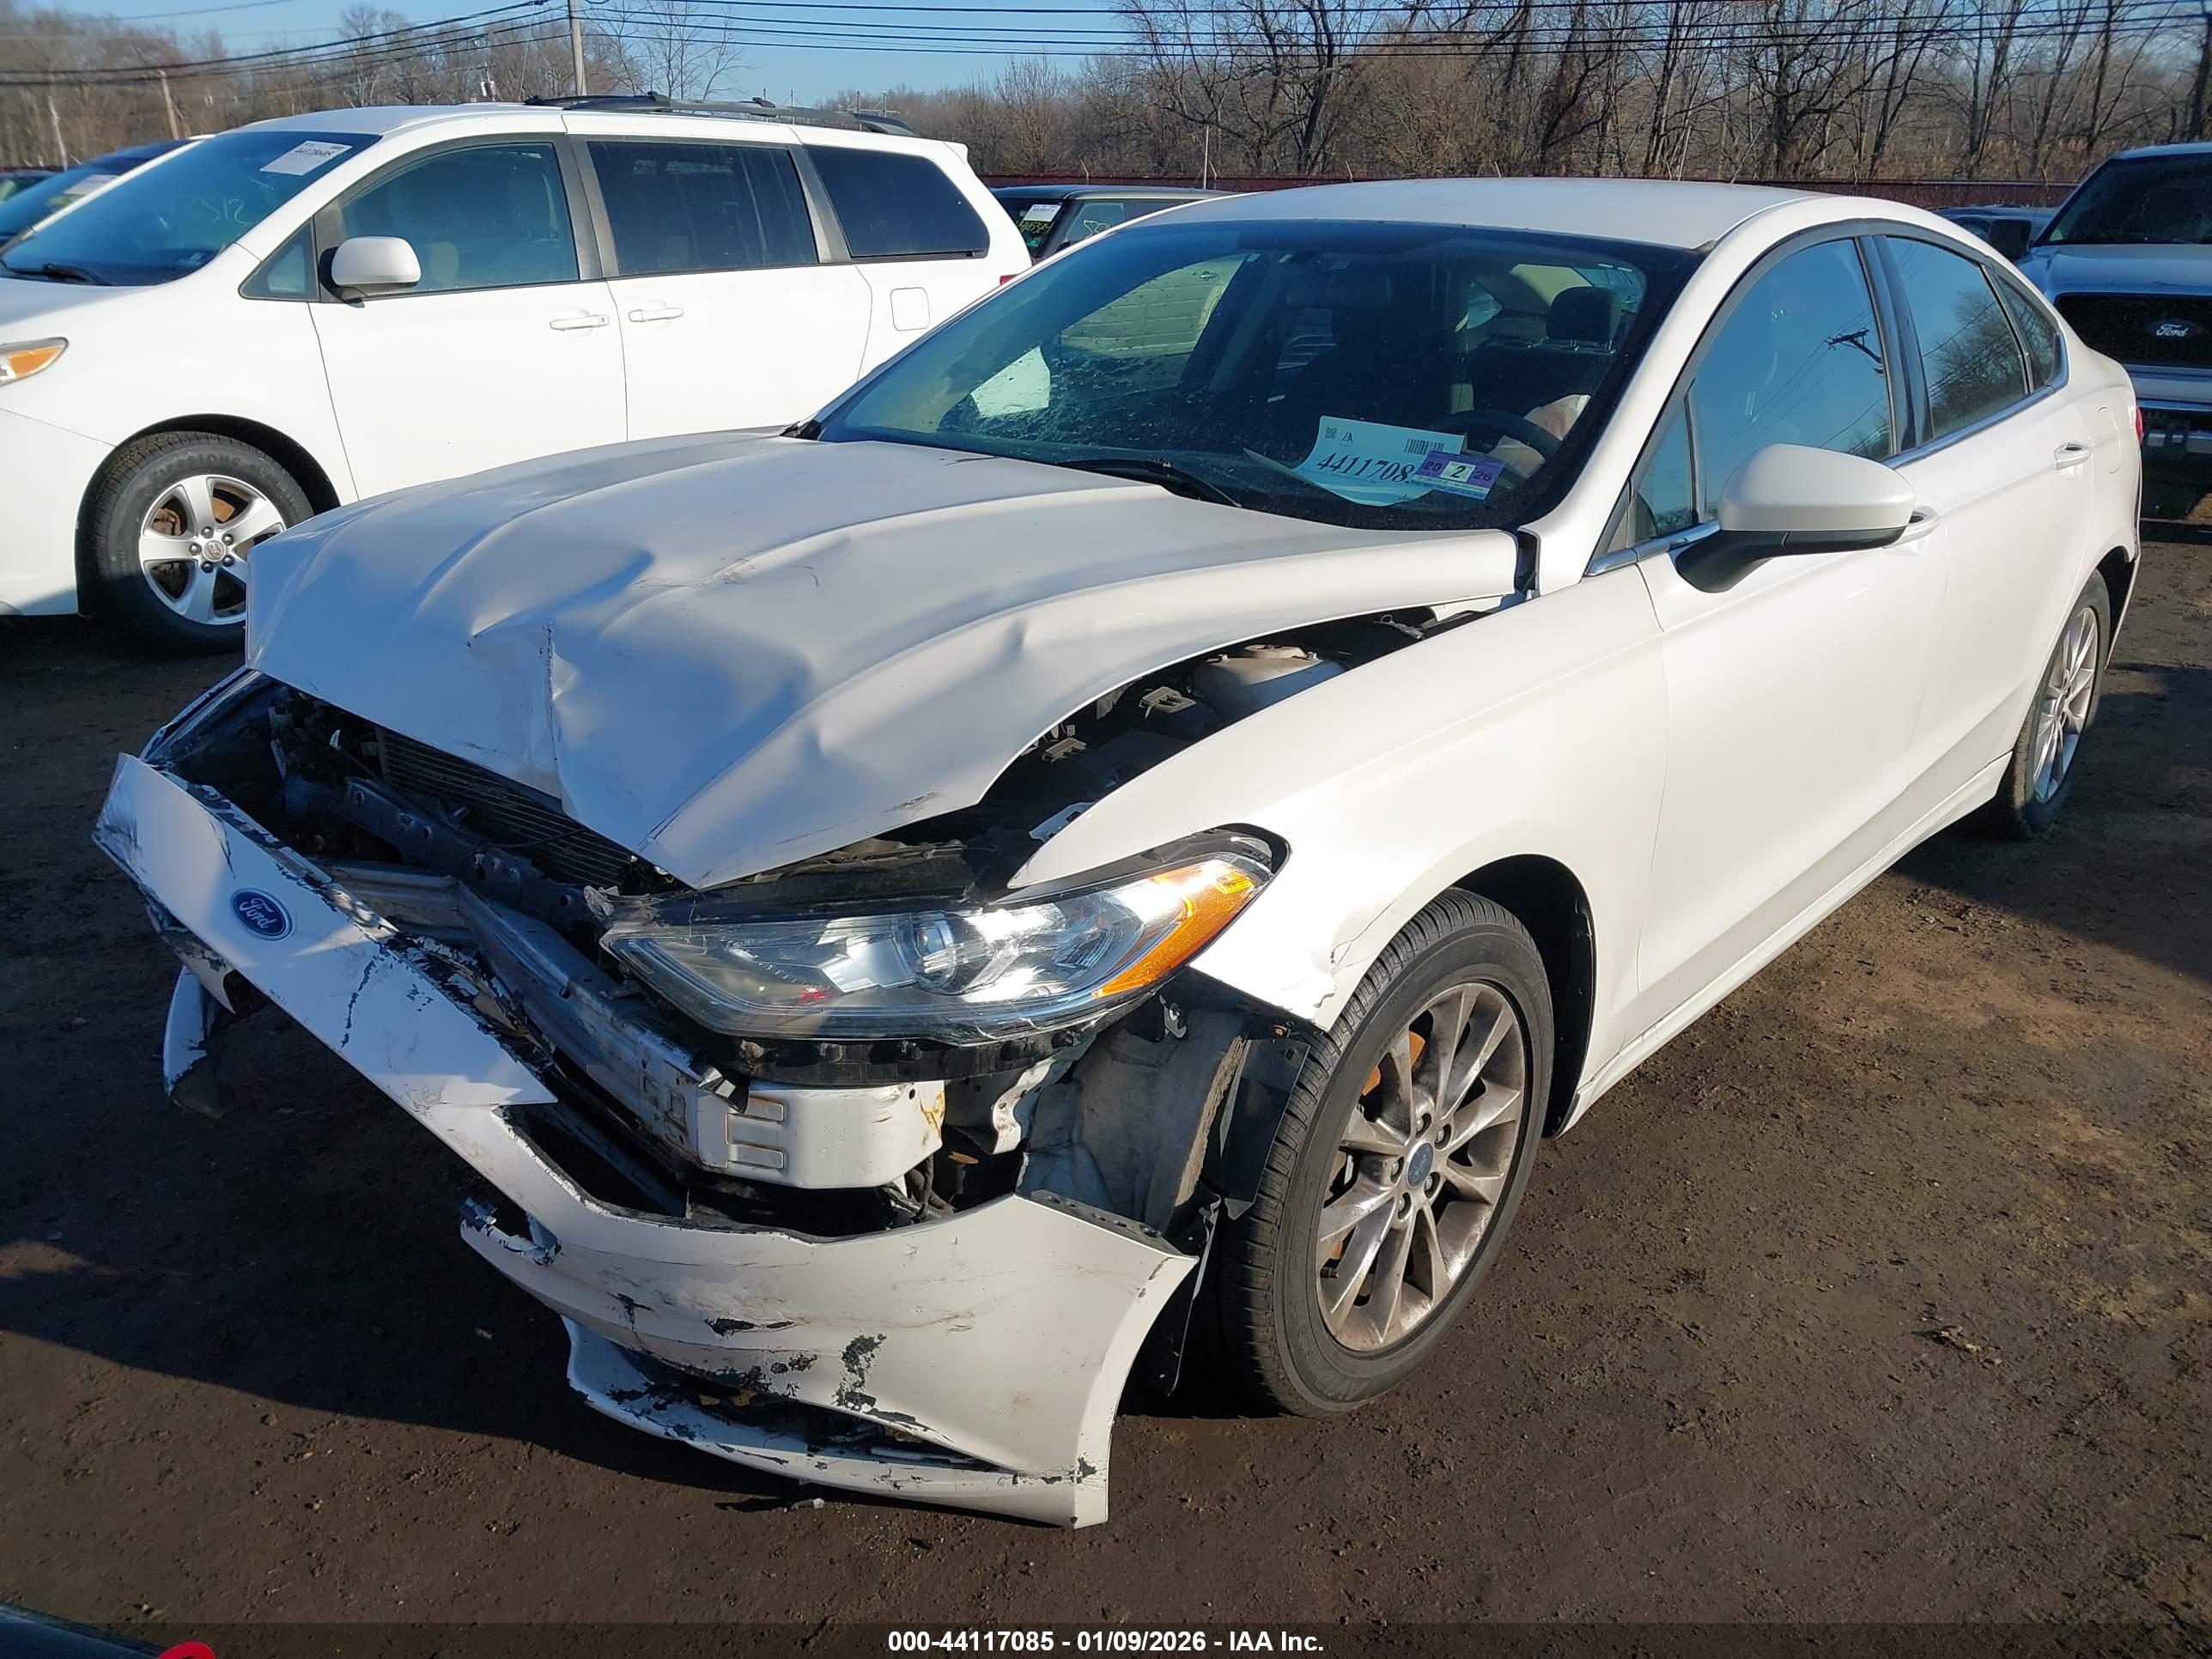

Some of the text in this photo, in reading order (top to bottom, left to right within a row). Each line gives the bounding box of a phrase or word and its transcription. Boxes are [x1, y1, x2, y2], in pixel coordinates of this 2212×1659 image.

[2156, 323, 2189, 337] Ford
[1316, 452, 1415, 483] 4411708
[1424, 461, 1494, 482] 20 2 26
[239, 897, 277, 929] Ford
